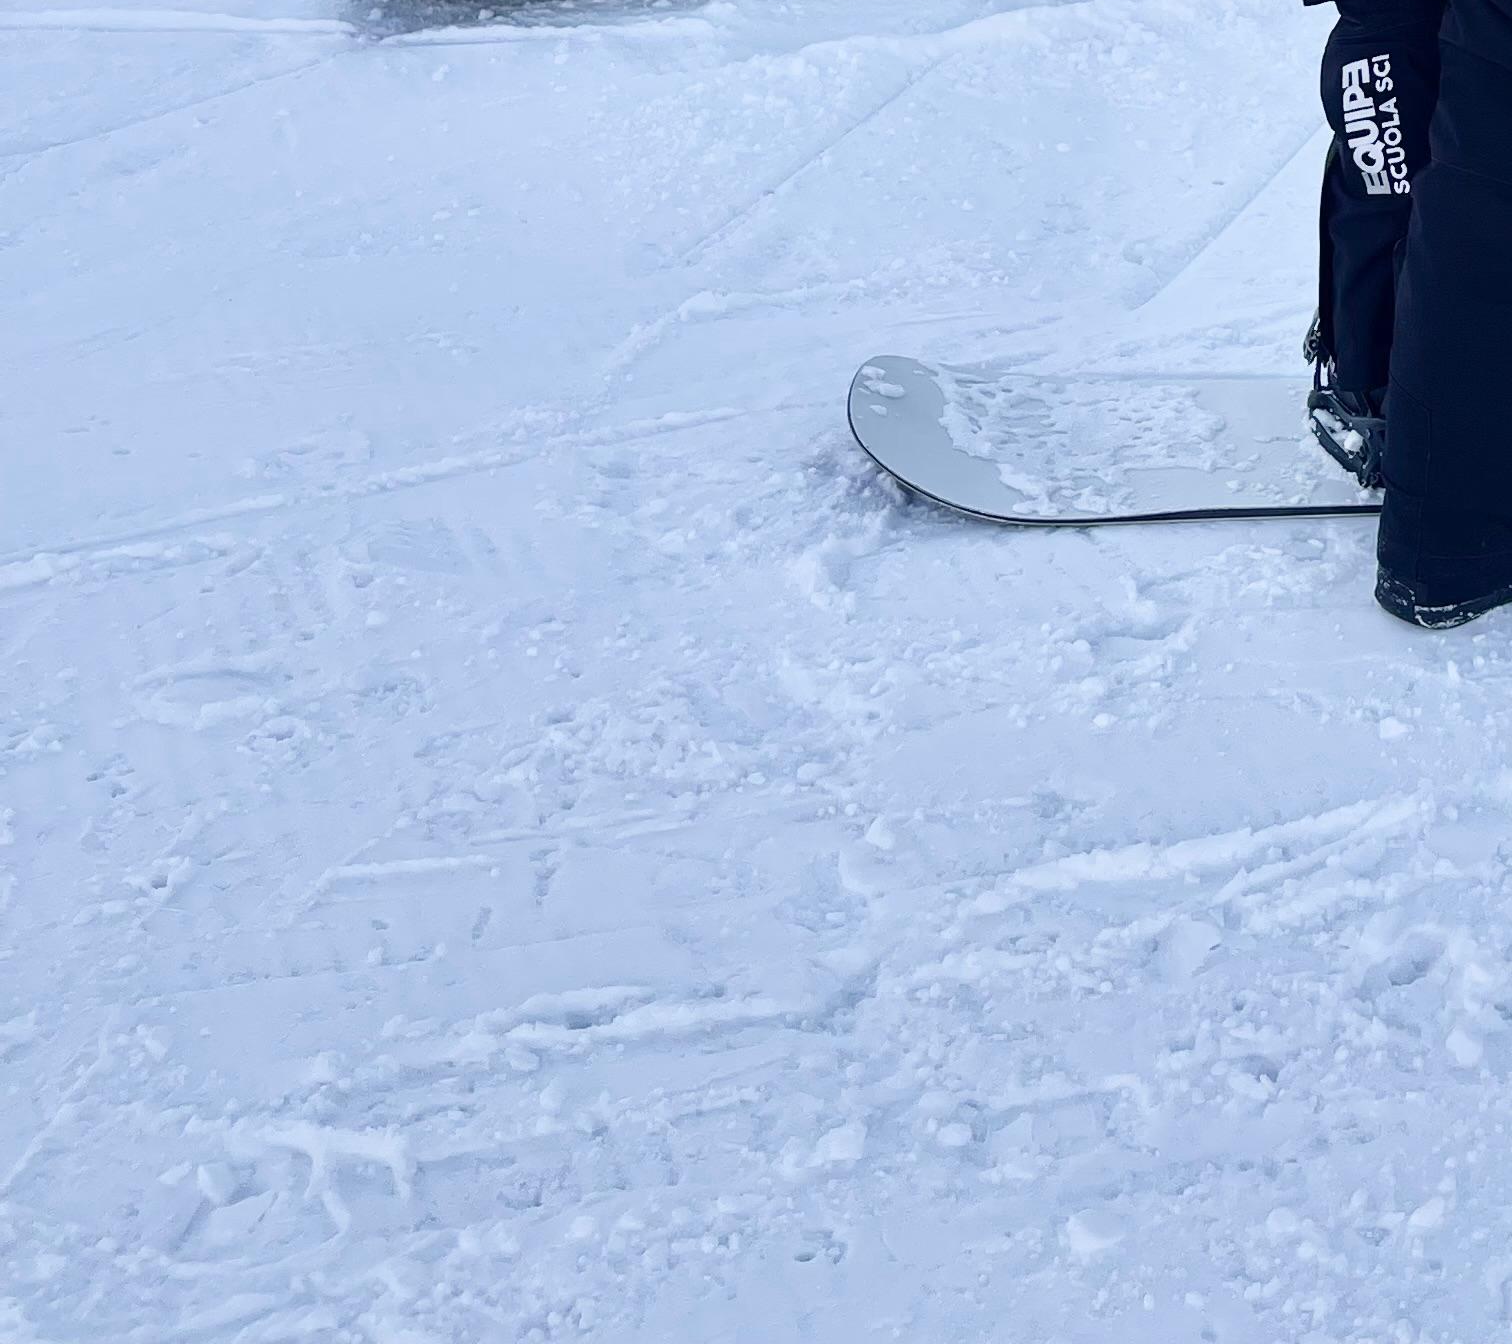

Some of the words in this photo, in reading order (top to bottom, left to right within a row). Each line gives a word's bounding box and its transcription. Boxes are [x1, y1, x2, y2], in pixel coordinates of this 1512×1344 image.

[1371, 54, 1394, 93] SCI
[1342, 58, 1392, 195] EQUIPE
[1378, 97, 1411, 195] SCUOLA
